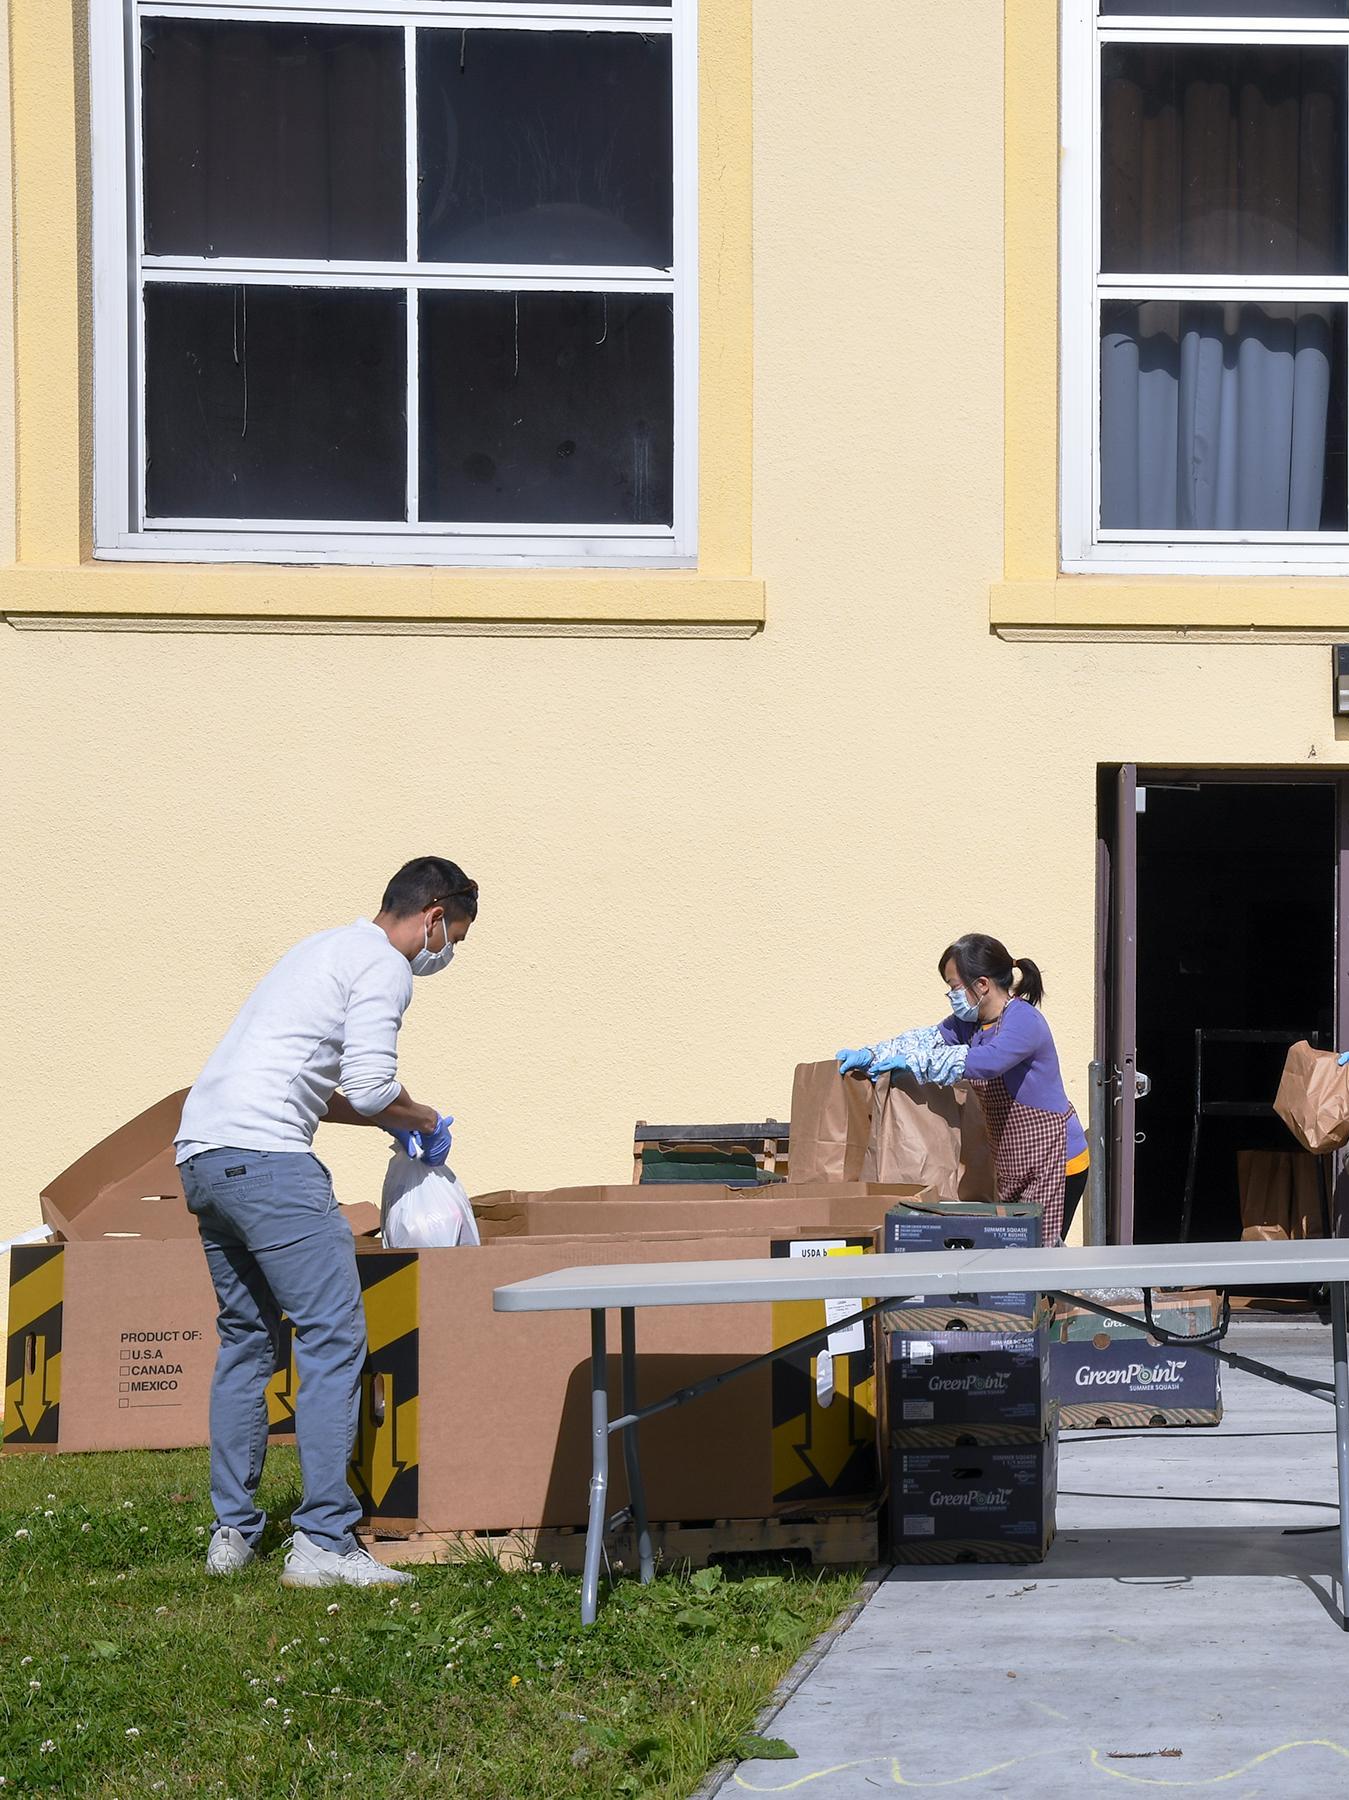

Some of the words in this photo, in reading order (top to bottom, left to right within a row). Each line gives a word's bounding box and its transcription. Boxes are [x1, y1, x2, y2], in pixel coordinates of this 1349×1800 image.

[802, 1248, 821, 1257] USDA
[121, 1331, 179, 1342] PRODUCT
[182, 1331, 202, 1341] OF:
[132, 1350, 163, 1360] U.S.A
[131, 1365, 183, 1375] CANADA
[1075, 1360, 1187, 1385] GreenPoint
[131, 1380, 178, 1391] MEXICO
[928, 1372, 1011, 1391] GreenPoint
[930, 1488, 1013, 1506] GreenPoint
